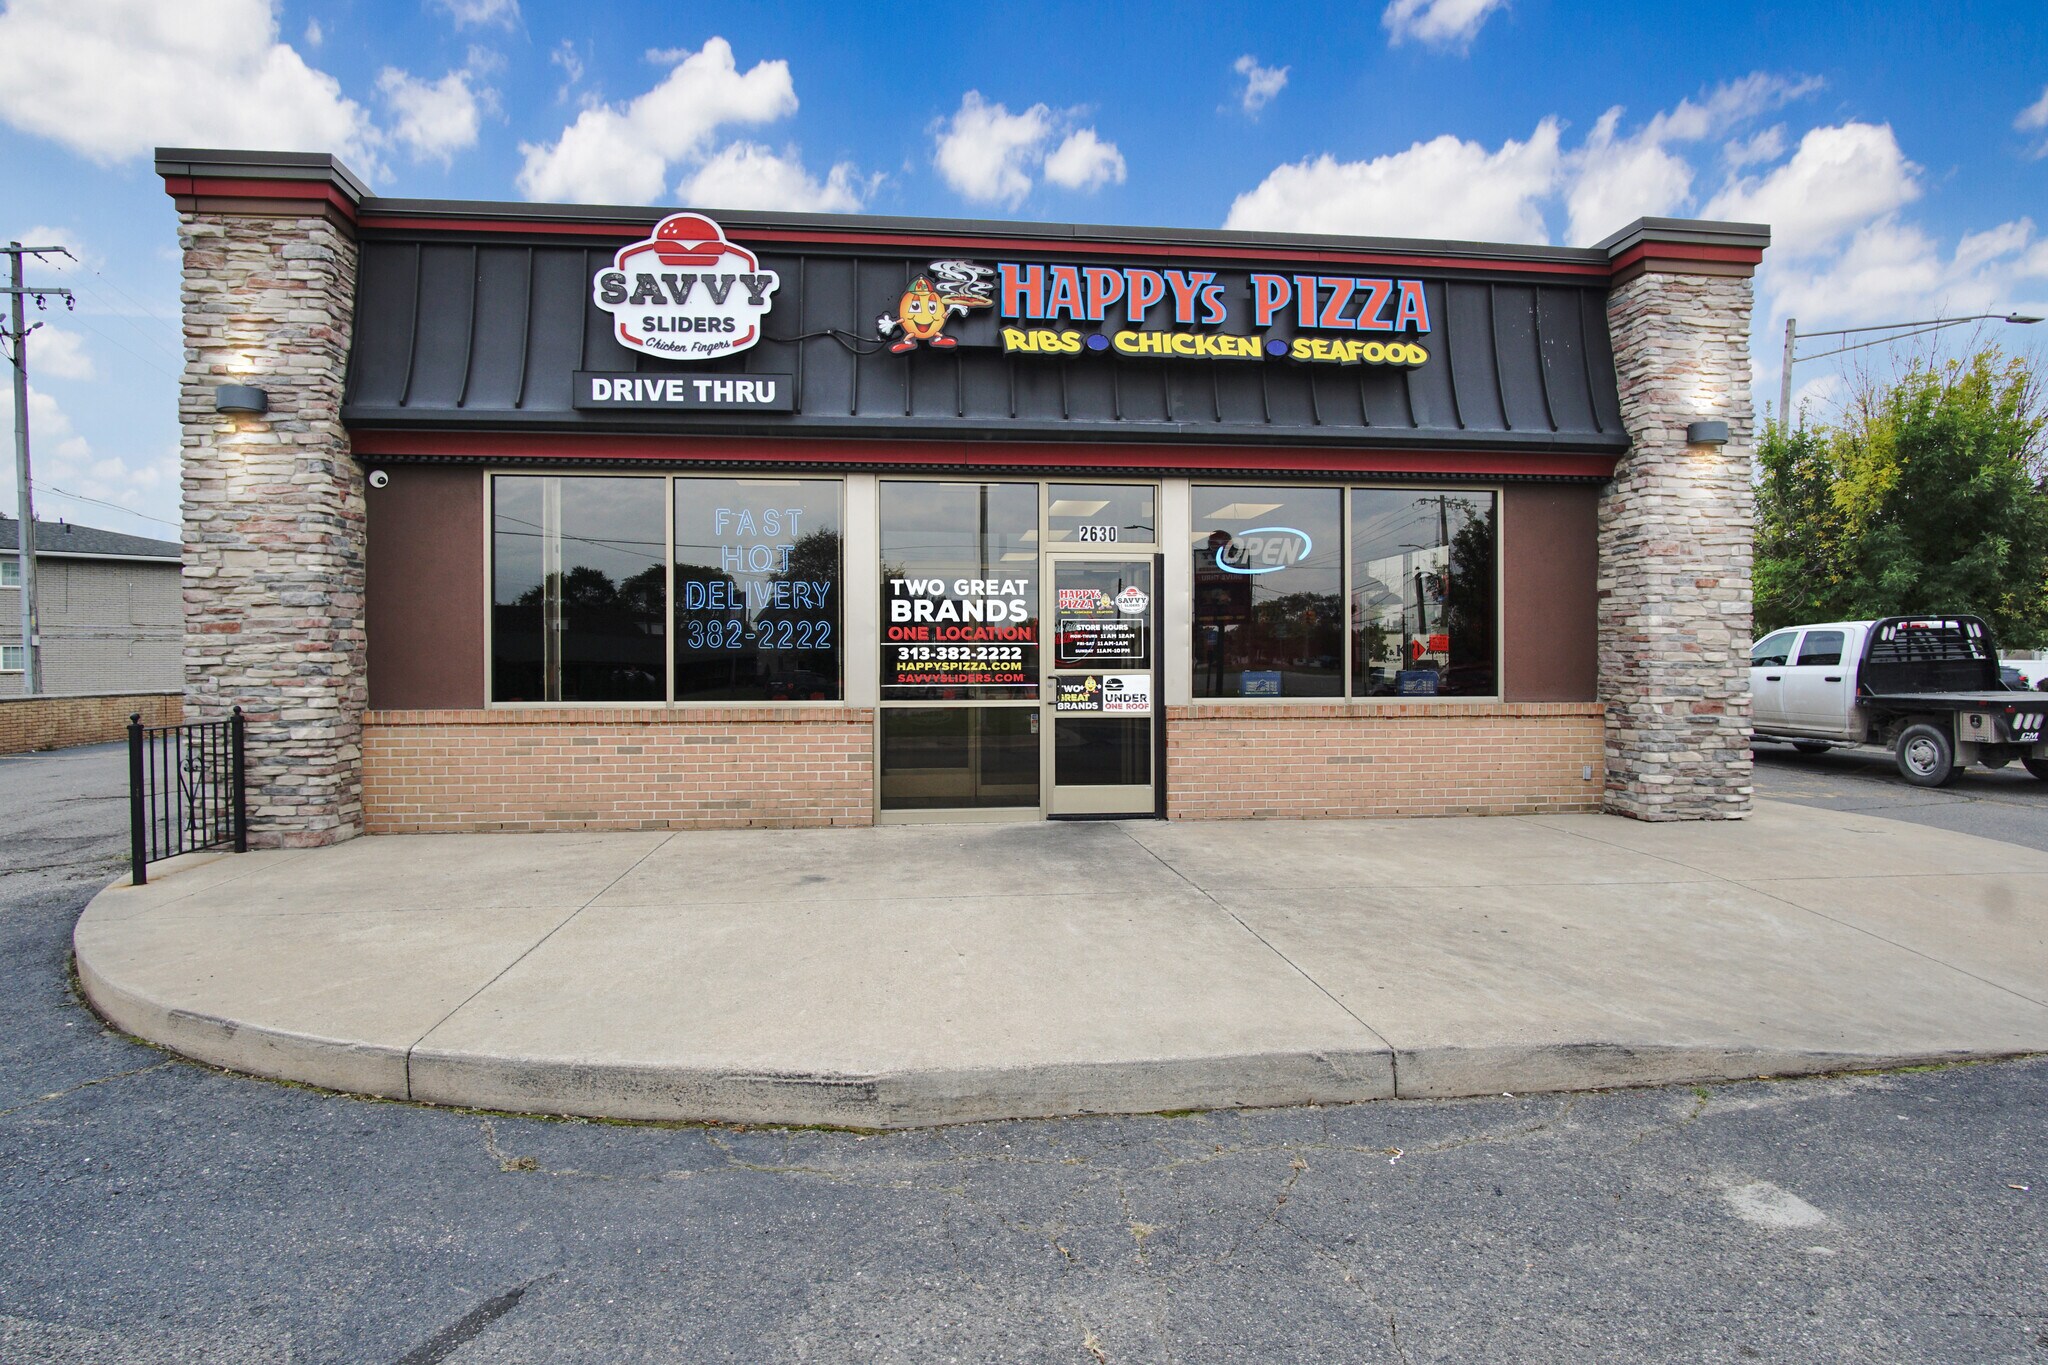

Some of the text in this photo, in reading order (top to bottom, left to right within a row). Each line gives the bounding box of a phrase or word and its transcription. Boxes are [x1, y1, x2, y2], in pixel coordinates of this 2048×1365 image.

[600, 272, 773, 306] SAVVY
[1250, 273, 1431, 332] PIZZA
[642, 315, 736, 333] SLIDERS
[645, 337, 731, 356] Chicken Fingers
[1003, 328, 1428, 364] RIBS CHICKEN SEAFOOD
[591, 378, 776, 403] DRIVE THRU
[715, 508, 803, 536] FAST
[1080, 526, 1116, 542] 2630
[721, 544, 795, 573] HOT
[1222, 537, 1301, 565] OPEN
[686, 581, 831, 610] DELIVERY
[890, 579, 1029, 596] TWO GREAT
[891, 599, 1028, 622] BRANDS
[1059, 599, 1094, 609] PIZZA
[687, 620, 831, 649] 382-2222
[888, 626, 1031, 641] ONE LOCATION
[898, 647, 1022, 660] 313-382-2222
[896, 662, 1022, 671] HAPPYSPIZZA.COM
[897, 673, 1024, 683] SAVVYSLIDERS.COM
[1057, 702, 1098, 710] BRANDS
[1105, 693, 1147, 702] UNDER
